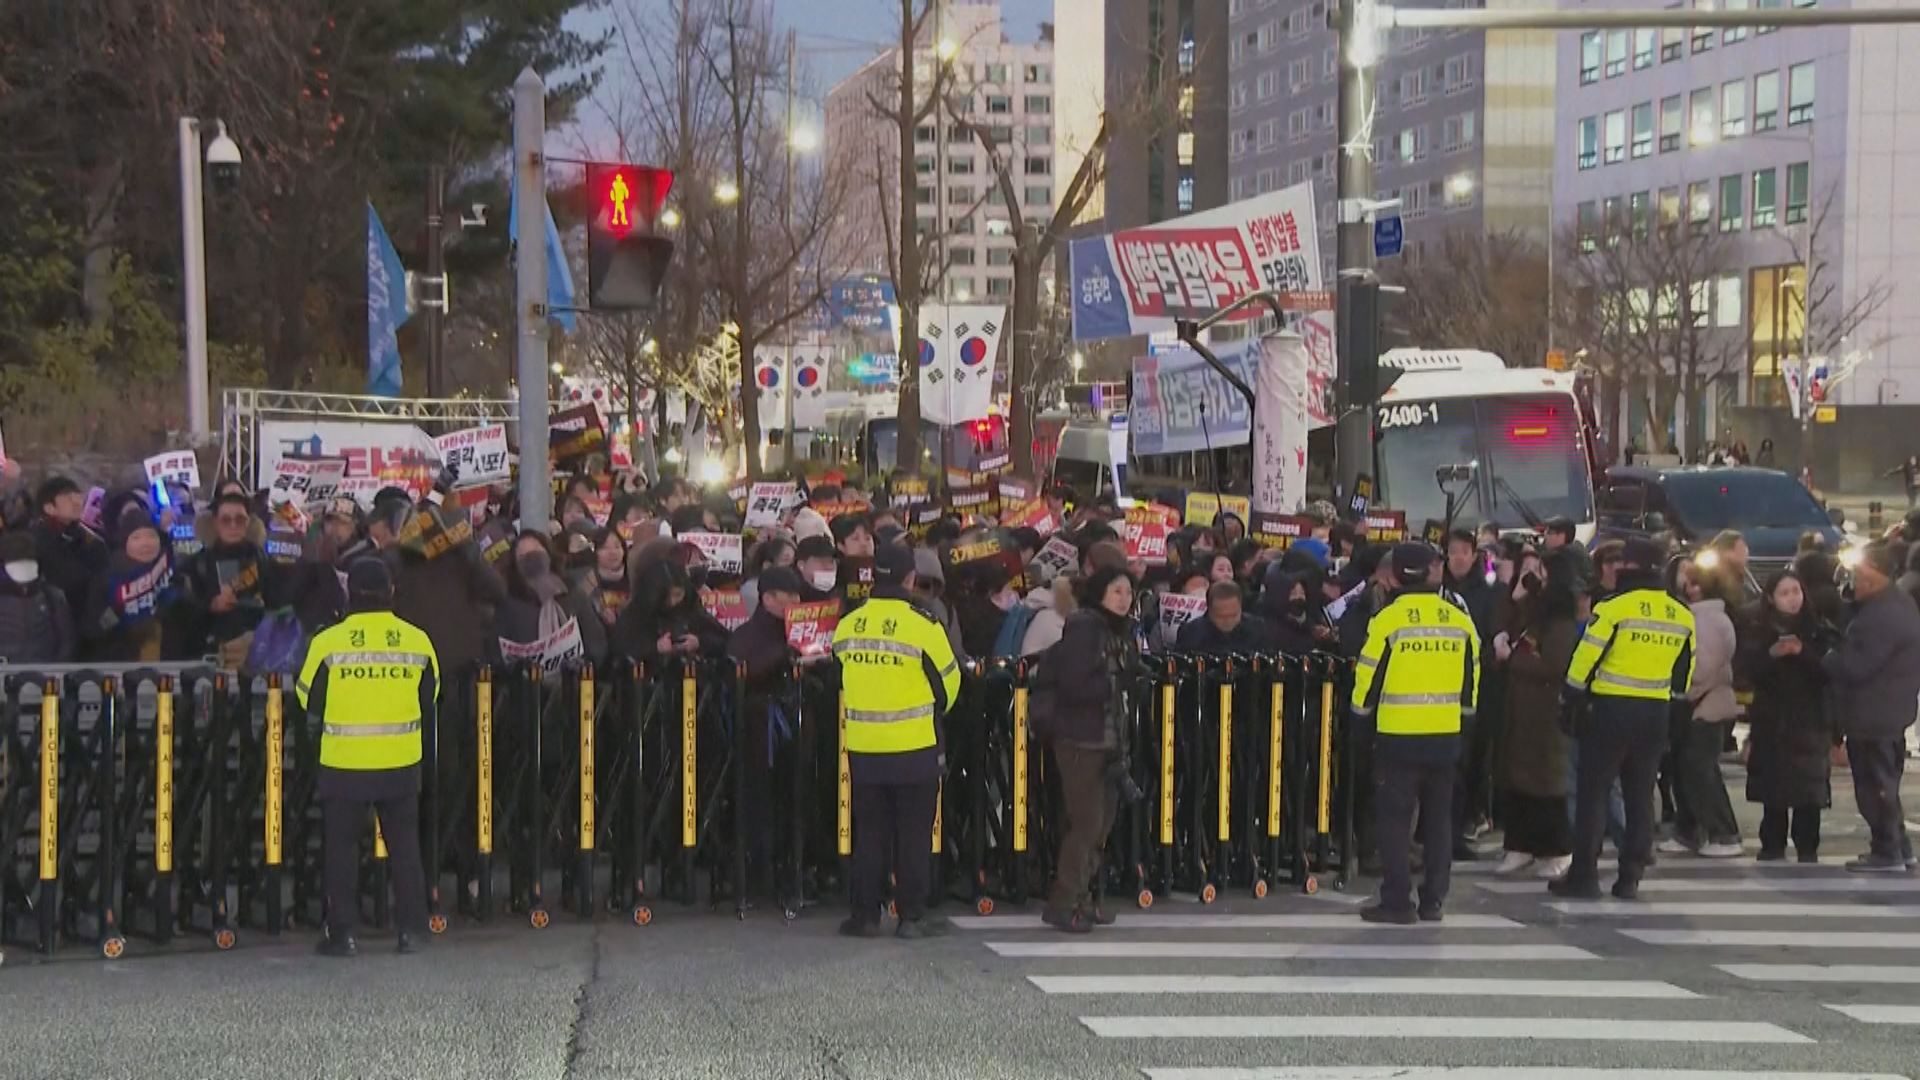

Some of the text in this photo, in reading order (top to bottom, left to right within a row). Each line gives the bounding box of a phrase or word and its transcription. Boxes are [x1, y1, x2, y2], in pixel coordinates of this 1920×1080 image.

[1379, 402, 1438, 428] 2400-1
[439, 431, 474, 450] 내란수괴
[274, 474, 311, 492] 즉각
[350, 629, 401, 647] 경찰
[1400, 641, 1459, 653] POLICE
[845, 653, 904, 666] POLICE
[340, 667, 414, 679] POLICE
[482, 712, 490, 835] POLICE LINE
[687, 708, 695, 829] POLICE LINE
[271, 719, 281, 846] POLICE LINE
[47, 728, 56, 862] POLICE LINE
